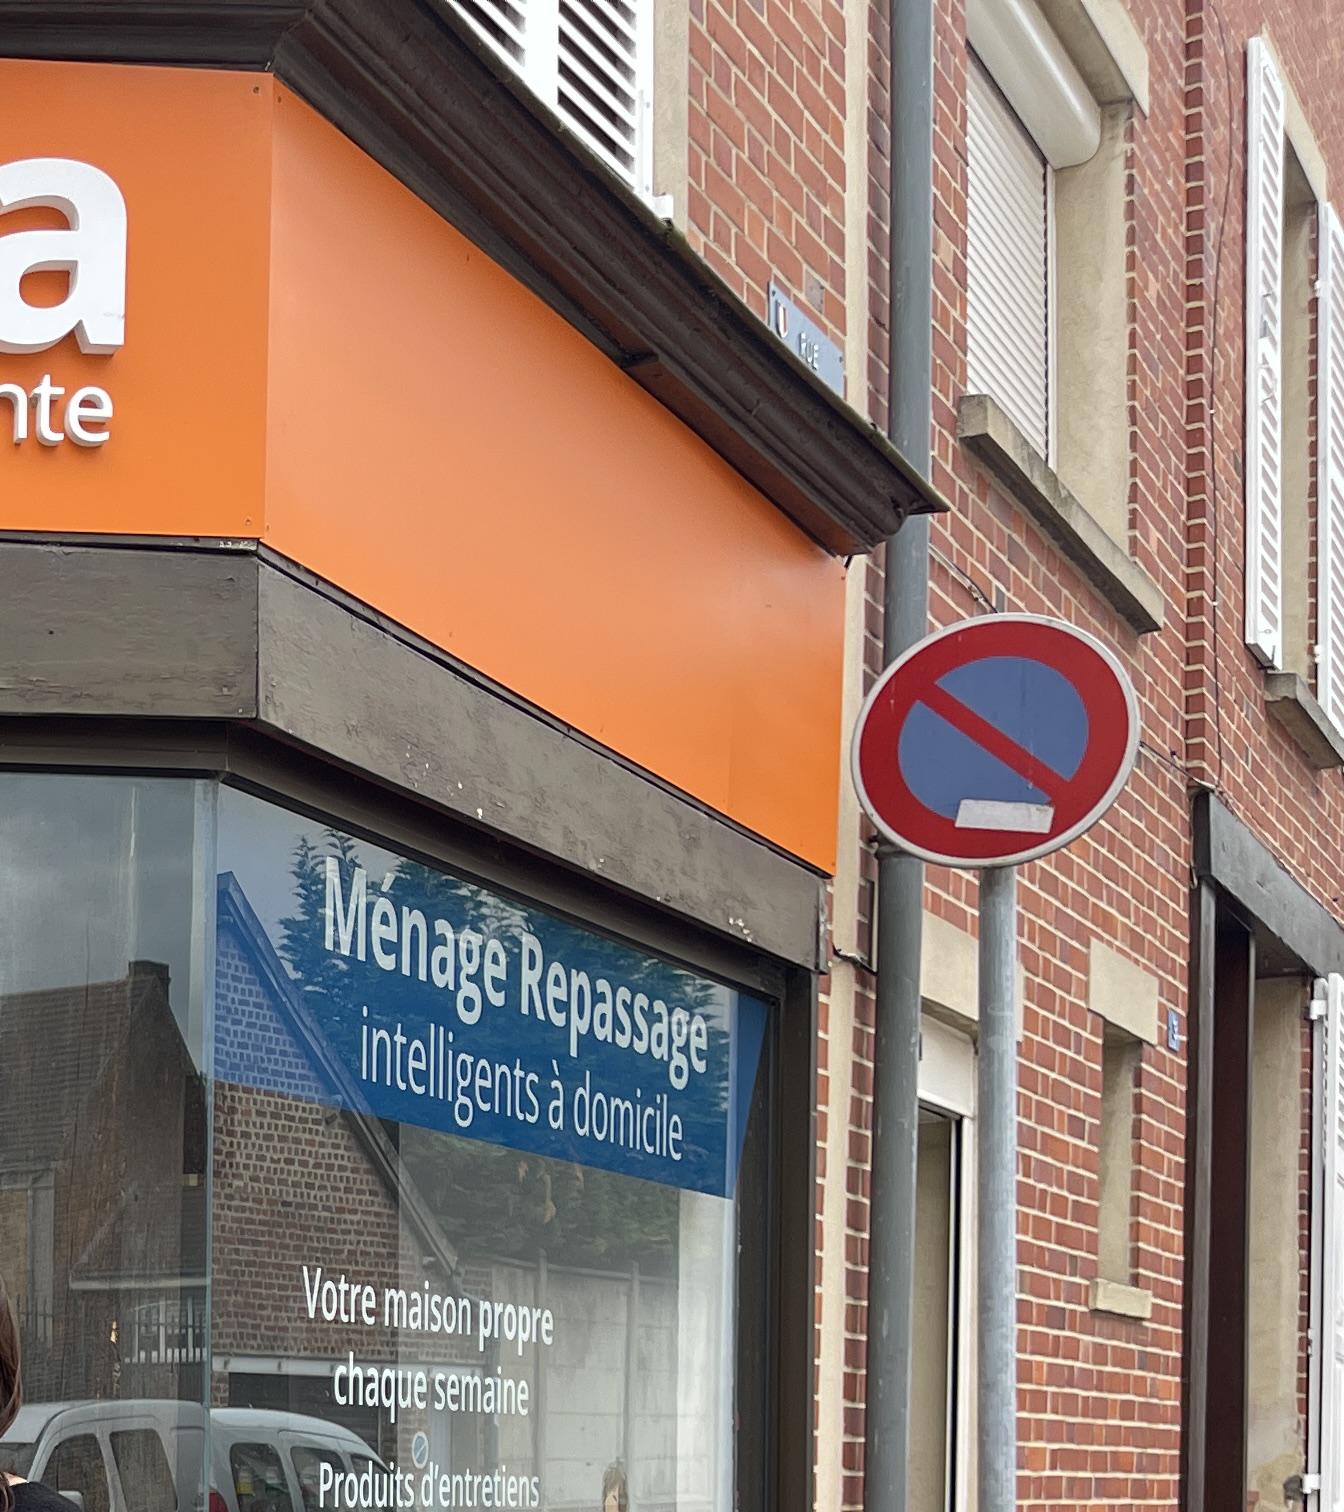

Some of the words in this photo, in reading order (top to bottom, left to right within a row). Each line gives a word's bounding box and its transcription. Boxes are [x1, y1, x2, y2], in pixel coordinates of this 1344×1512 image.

[324, 856, 507, 1025] Ménage
[521, 930, 708, 1090] Repassage
[361, 1005, 539, 1128] intelligents
[548, 1060, 564, 1131] à
[573, 1069, 683, 1161] domicile
[302, 1265, 376, 1326] Votre
[384, 1280, 471, 1336] maison
[479, 1300, 554, 1356] propre
[333, 1351, 428, 1423] chaque
[434, 1365, 530, 1416] semaine
[319, 1460, 414, 1509] Produits
[421, 1461, 540, 1508] d'entretiens
